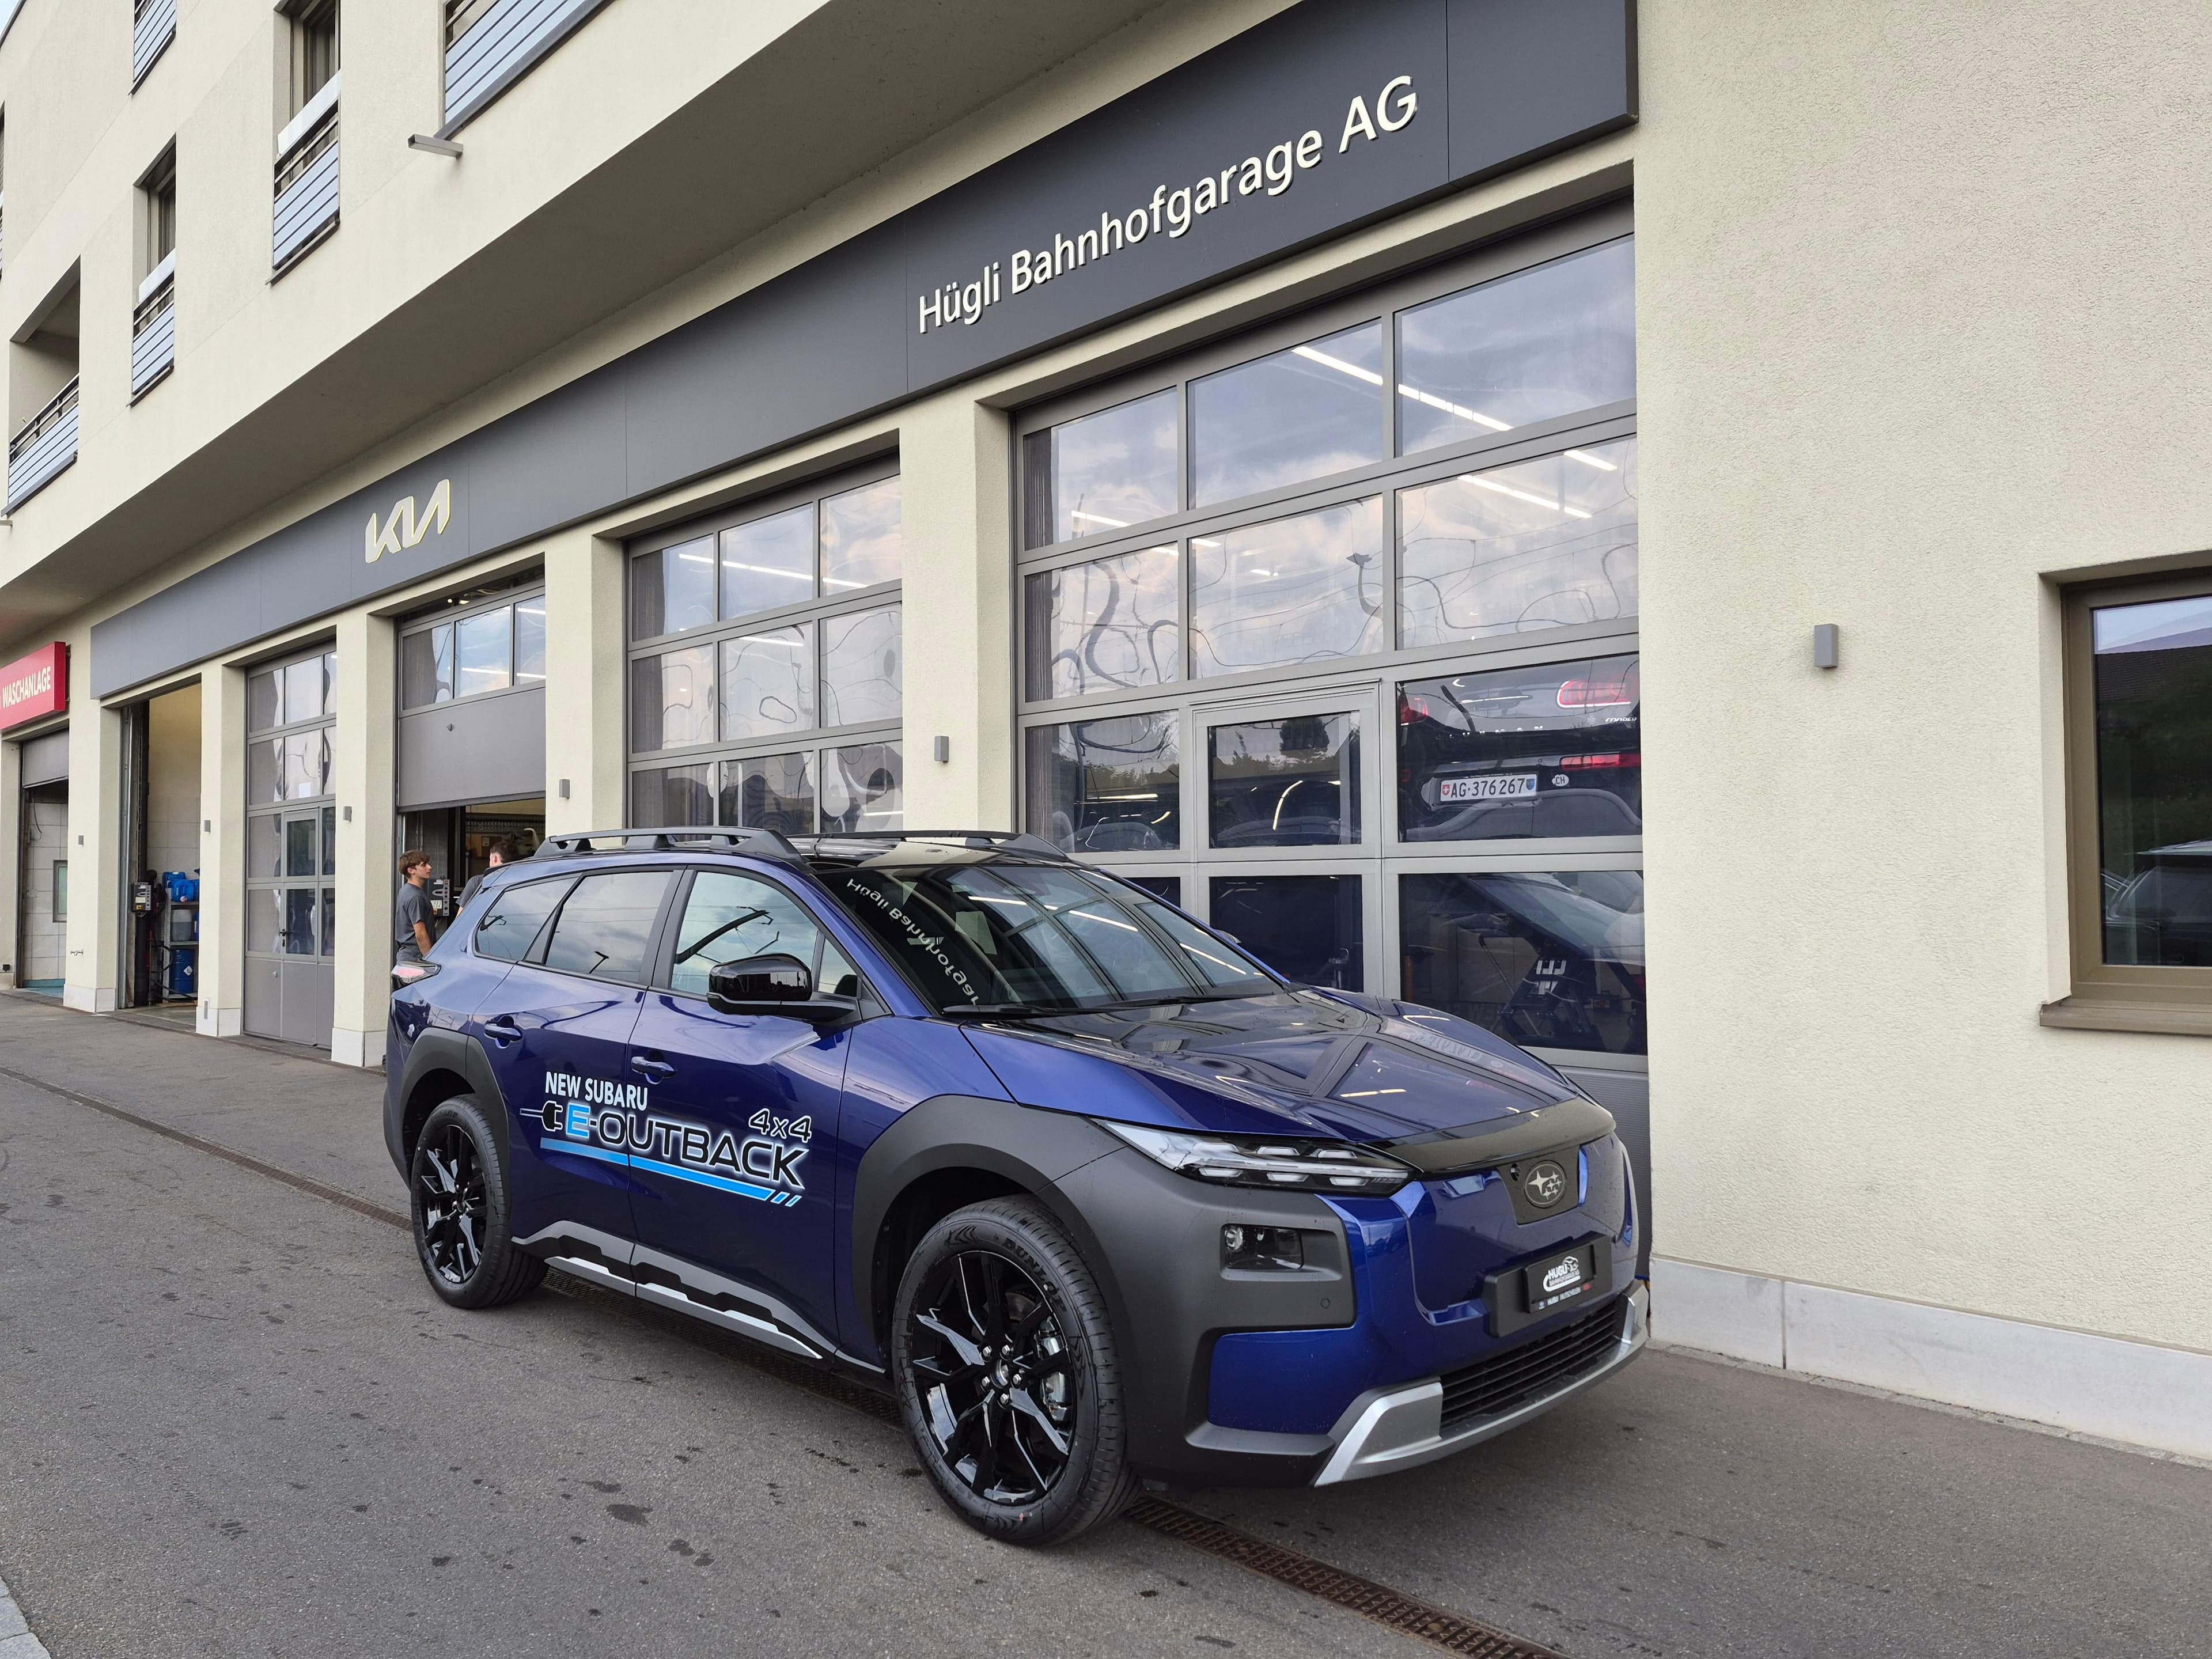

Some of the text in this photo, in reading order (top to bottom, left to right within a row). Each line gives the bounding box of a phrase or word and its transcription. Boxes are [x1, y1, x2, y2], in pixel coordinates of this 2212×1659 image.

[919, 75, 1418, 333] Hügli Bahnhofgarage AG
[365, 479, 450, 563] KIA
[2, 666, 51, 708] WASCHANLAGE
[1556, 776, 1566, 785] CH
[545, 1071, 648, 1111] NEW SUBARU
[566, 1102, 810, 1190] E-OUTBACK
[1002, 1237, 1067, 1312] DUNLOP
